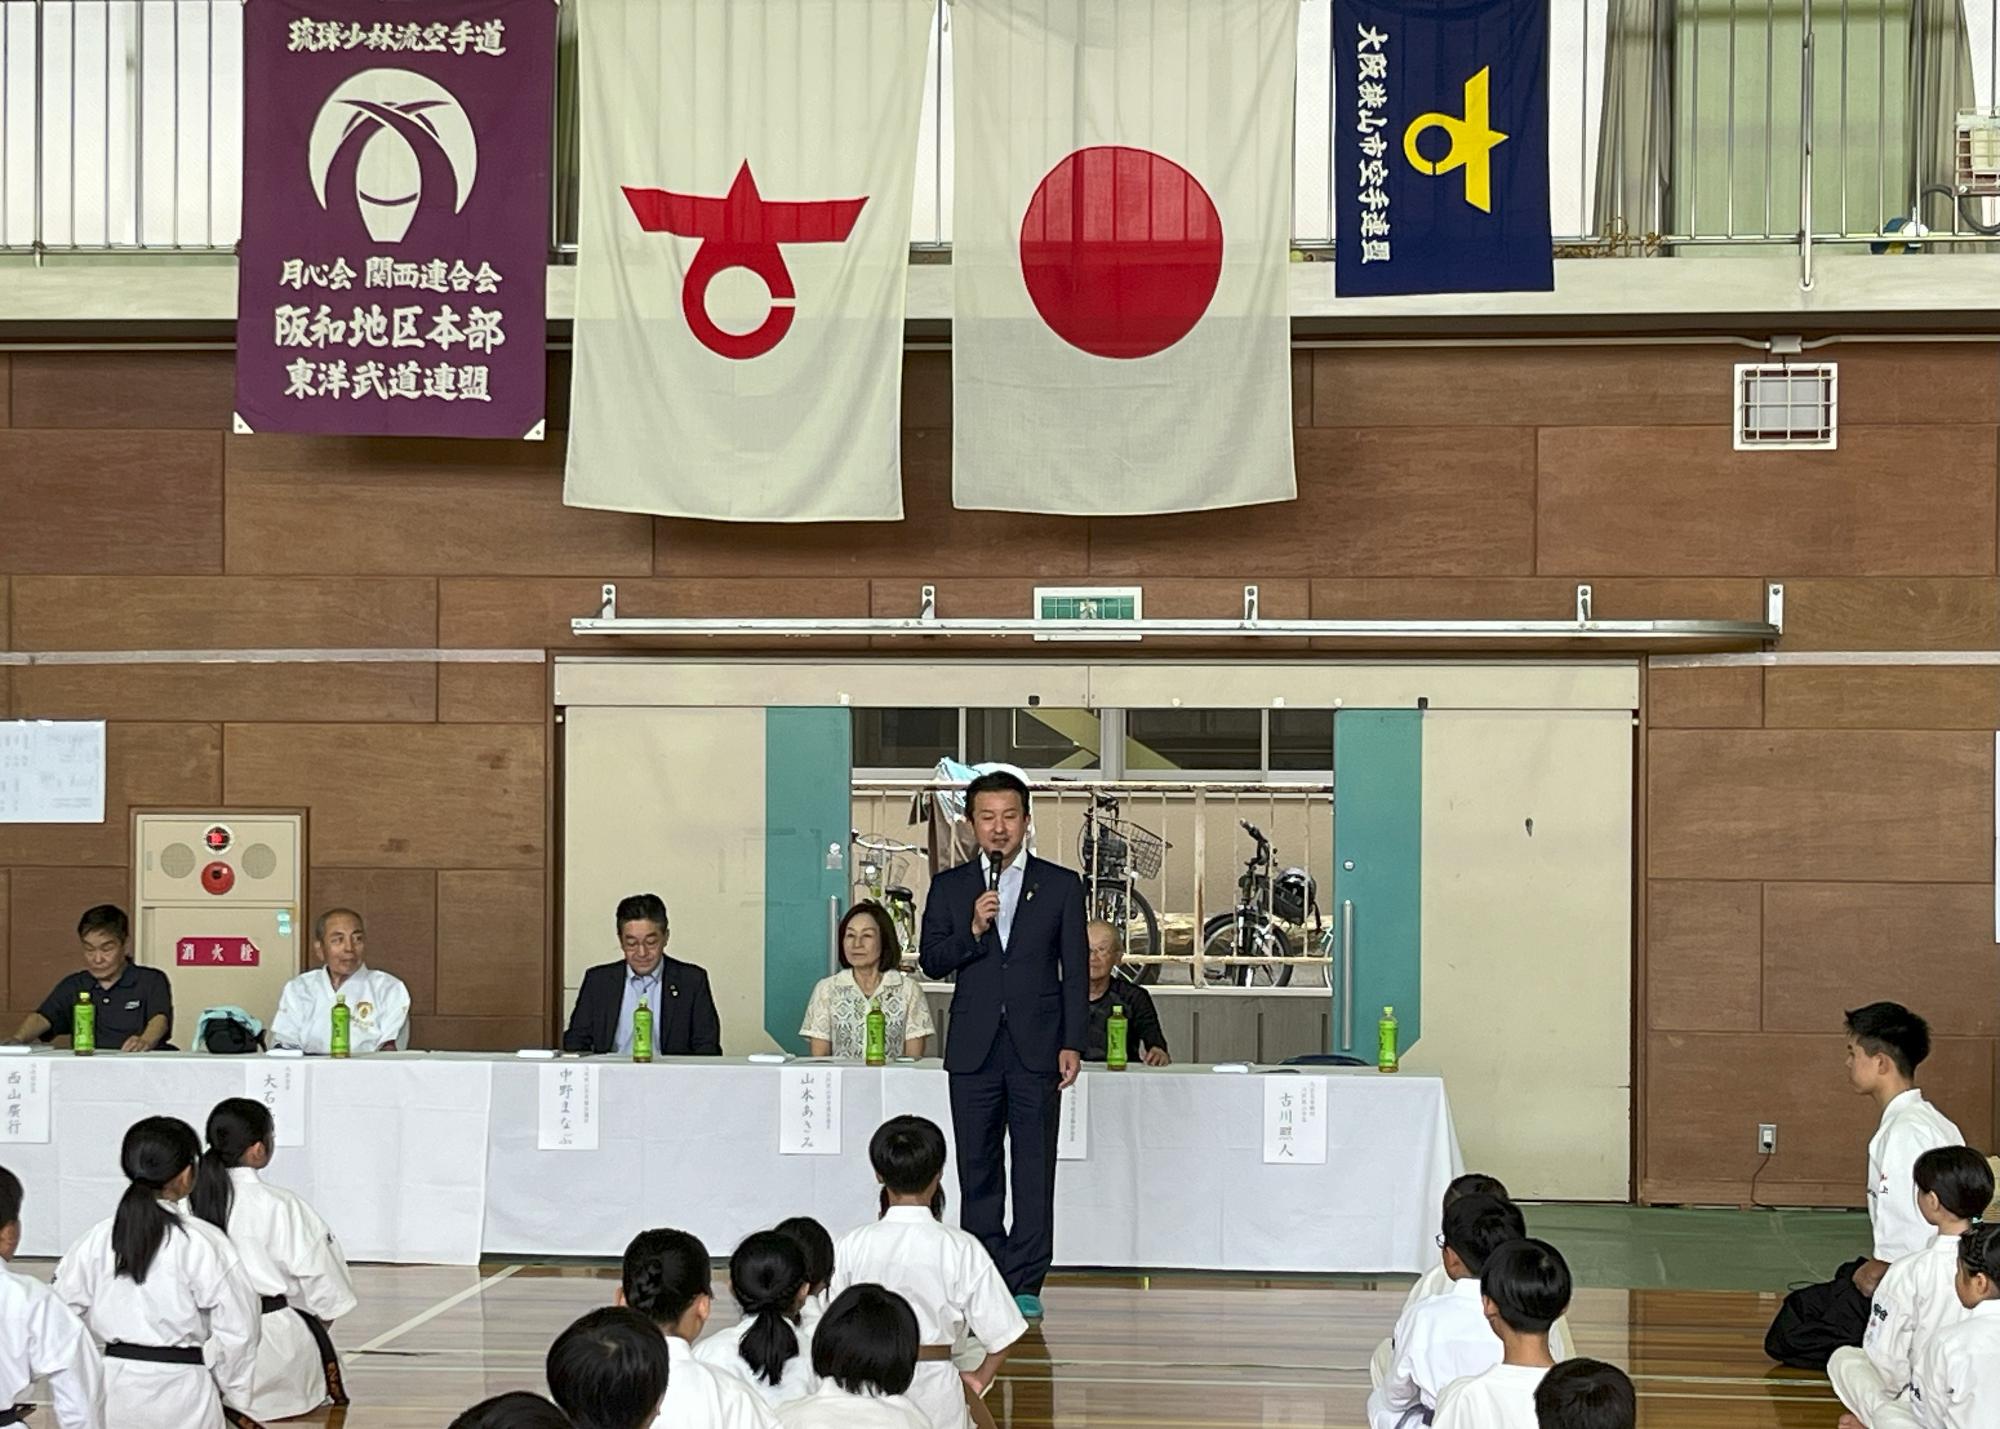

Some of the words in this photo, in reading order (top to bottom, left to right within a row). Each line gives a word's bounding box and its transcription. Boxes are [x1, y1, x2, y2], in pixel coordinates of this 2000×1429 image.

[287, 17, 506, 56] 琉球少林流空手道
[1356, 22, 1391, 264] 大阪狭山市空手連盟
[279, 257, 358, 290] 月心会
[364, 256, 503, 294] 関西連合会
[274, 303, 506, 355] 阪和地区本部
[284, 357, 493, 402] 東洋武道連盟
[559, 1067, 574, 1145] 中野まなぶ
